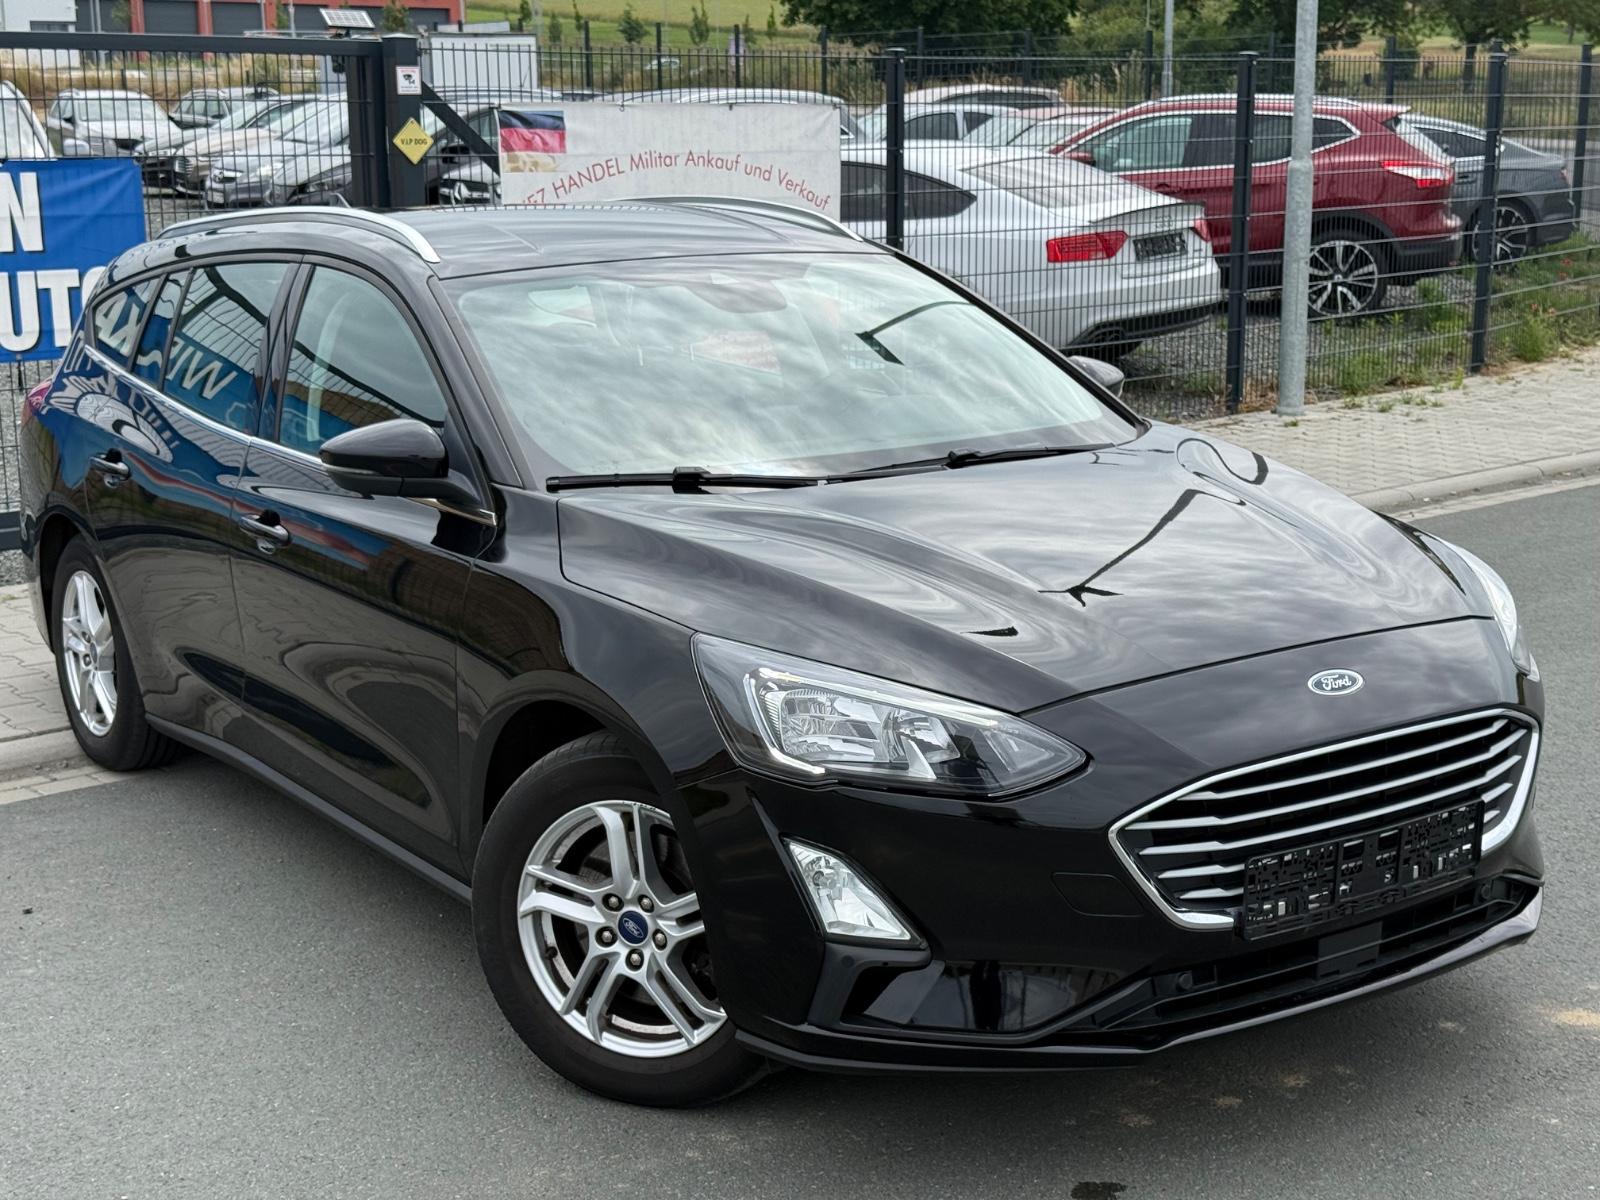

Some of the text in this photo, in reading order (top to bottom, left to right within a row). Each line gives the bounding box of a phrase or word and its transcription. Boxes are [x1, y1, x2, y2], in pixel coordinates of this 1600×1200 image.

[552, 157, 625, 199] HANDEL
[685, 150, 742, 172] Ankauf
[744, 160, 771, 181] und
[777, 169, 831, 211] Verkauf
[1321, 674, 1351, 690] Ford
